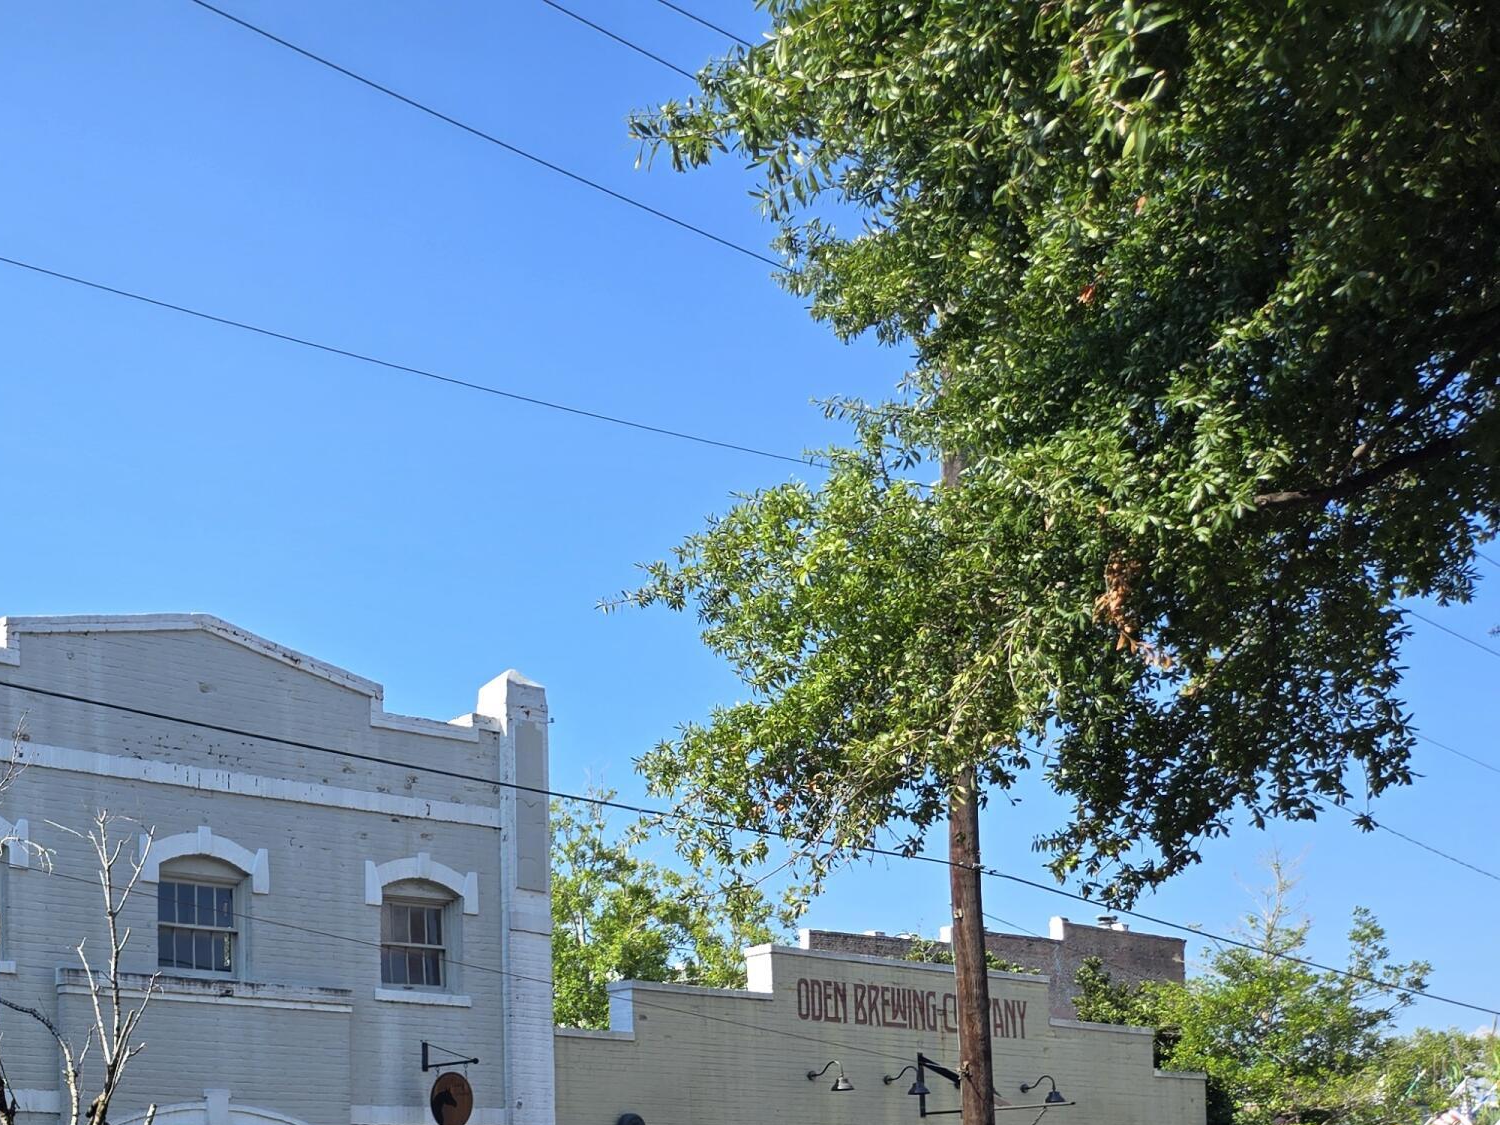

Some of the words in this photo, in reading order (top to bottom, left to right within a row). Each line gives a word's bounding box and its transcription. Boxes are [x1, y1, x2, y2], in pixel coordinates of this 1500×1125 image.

[797, 978, 848, 1024] ODEN
[853, 983, 938, 1032] BREWING
[942, 992, 1027, 1040] CANY
